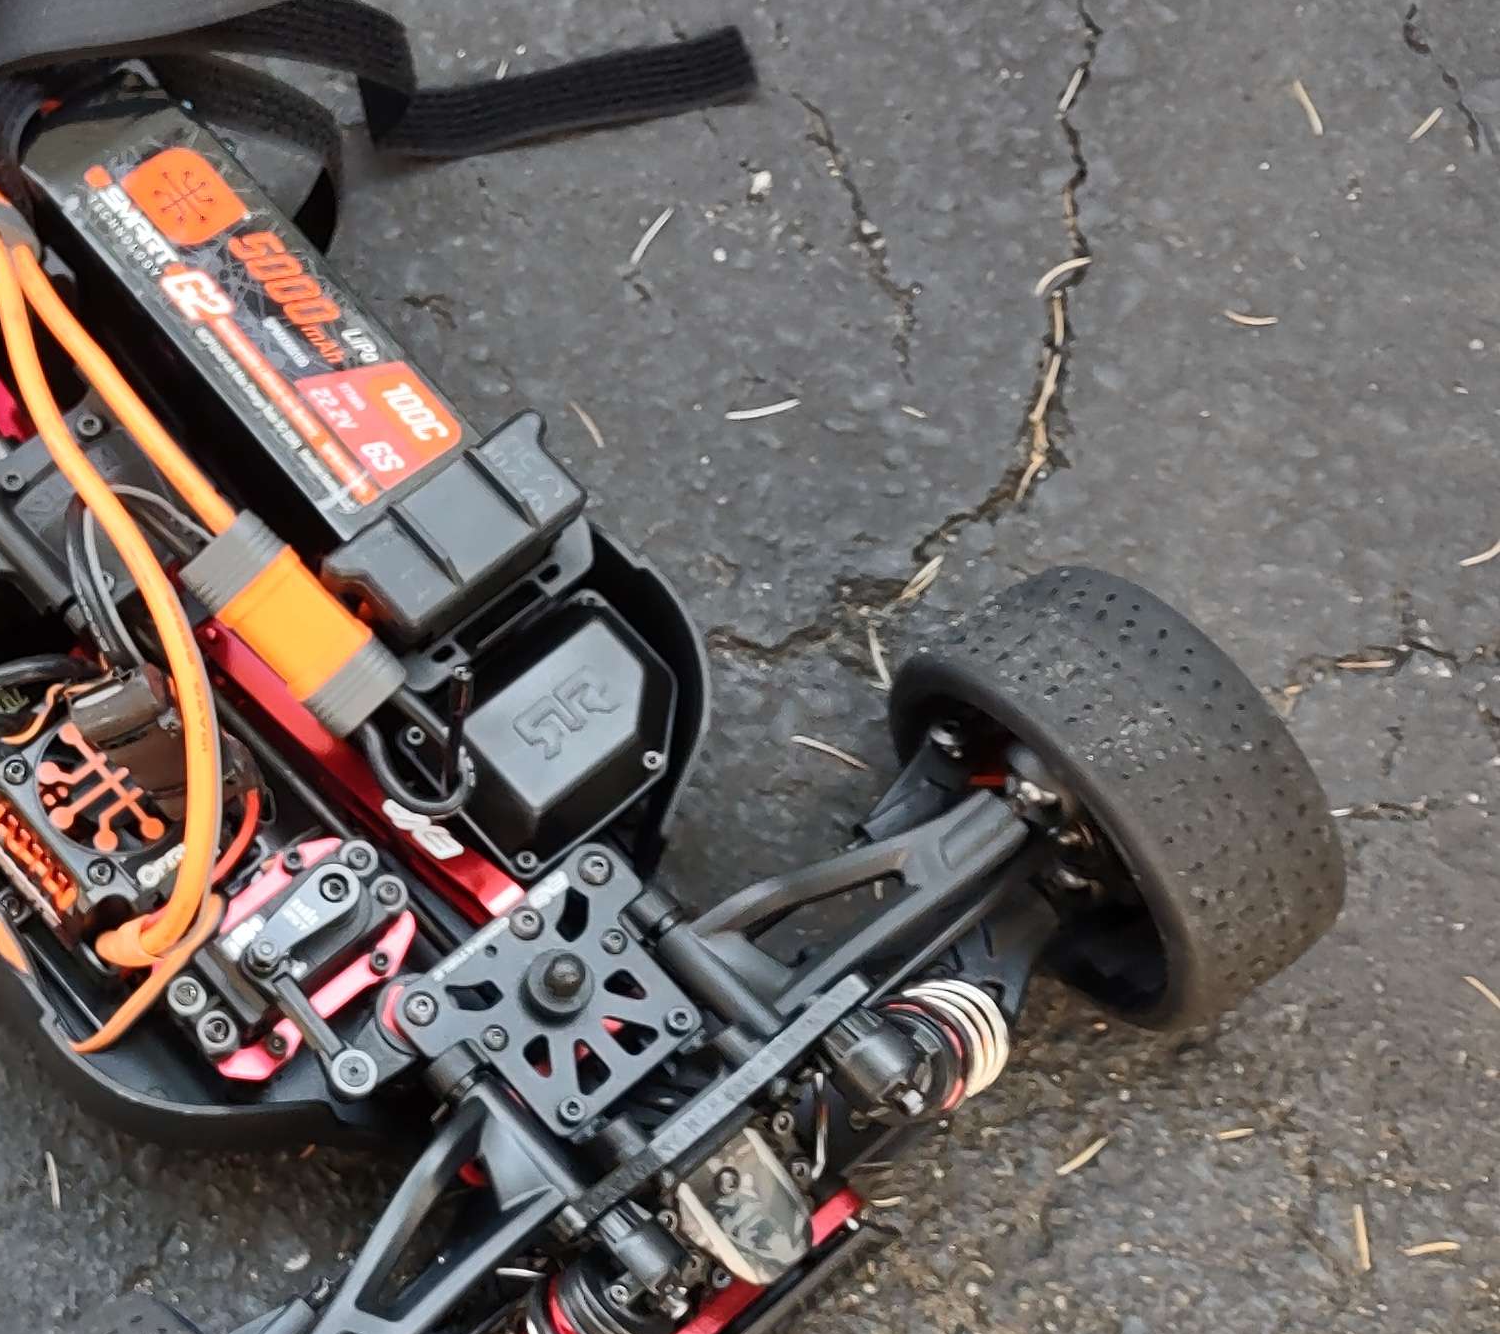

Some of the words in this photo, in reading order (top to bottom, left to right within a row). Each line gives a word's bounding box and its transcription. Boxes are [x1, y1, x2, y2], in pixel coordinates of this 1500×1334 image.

[89, 196, 161, 277] TECHNOLOGY
[161, 270, 233, 322] G2
[307, 386, 360, 433] 22.2V
[380, 381, 449, 441] 100C
[358, 439, 405, 474] 6S
